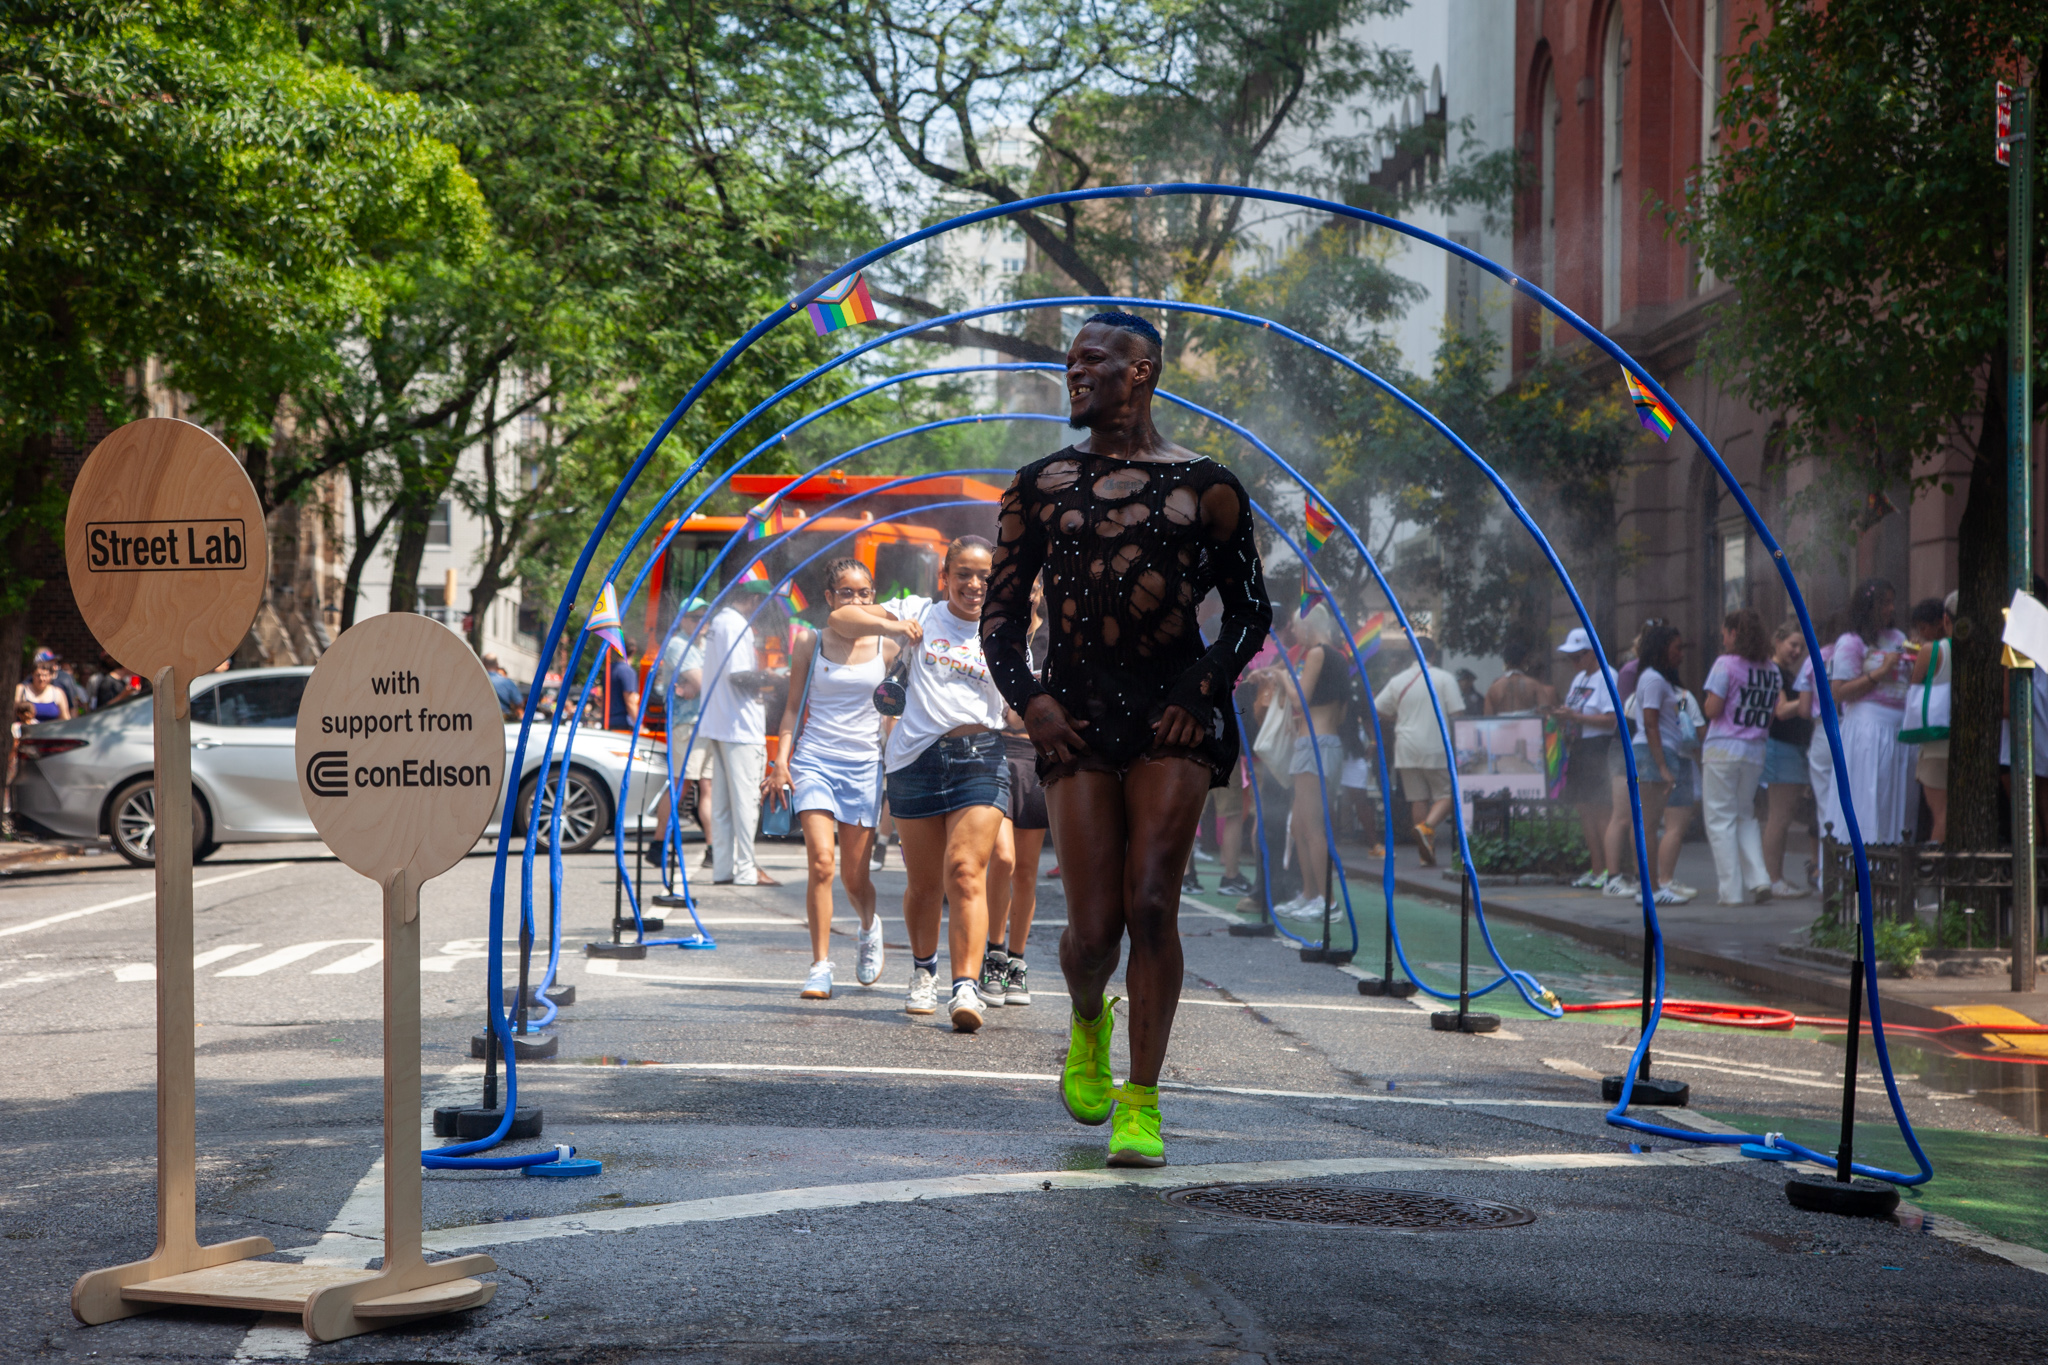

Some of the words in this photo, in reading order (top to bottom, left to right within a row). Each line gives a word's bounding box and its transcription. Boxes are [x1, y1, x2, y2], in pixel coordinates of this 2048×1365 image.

[90, 528, 179, 566] Street
[187, 526, 242, 564] Lab
[371, 670, 420, 695] with
[1748, 667, 1779, 690] LIVE
[321, 708, 413, 739] support
[418, 708, 472, 732] from
[1733, 706, 1771, 728] LOO
[354, 759, 491, 788] conEdison
